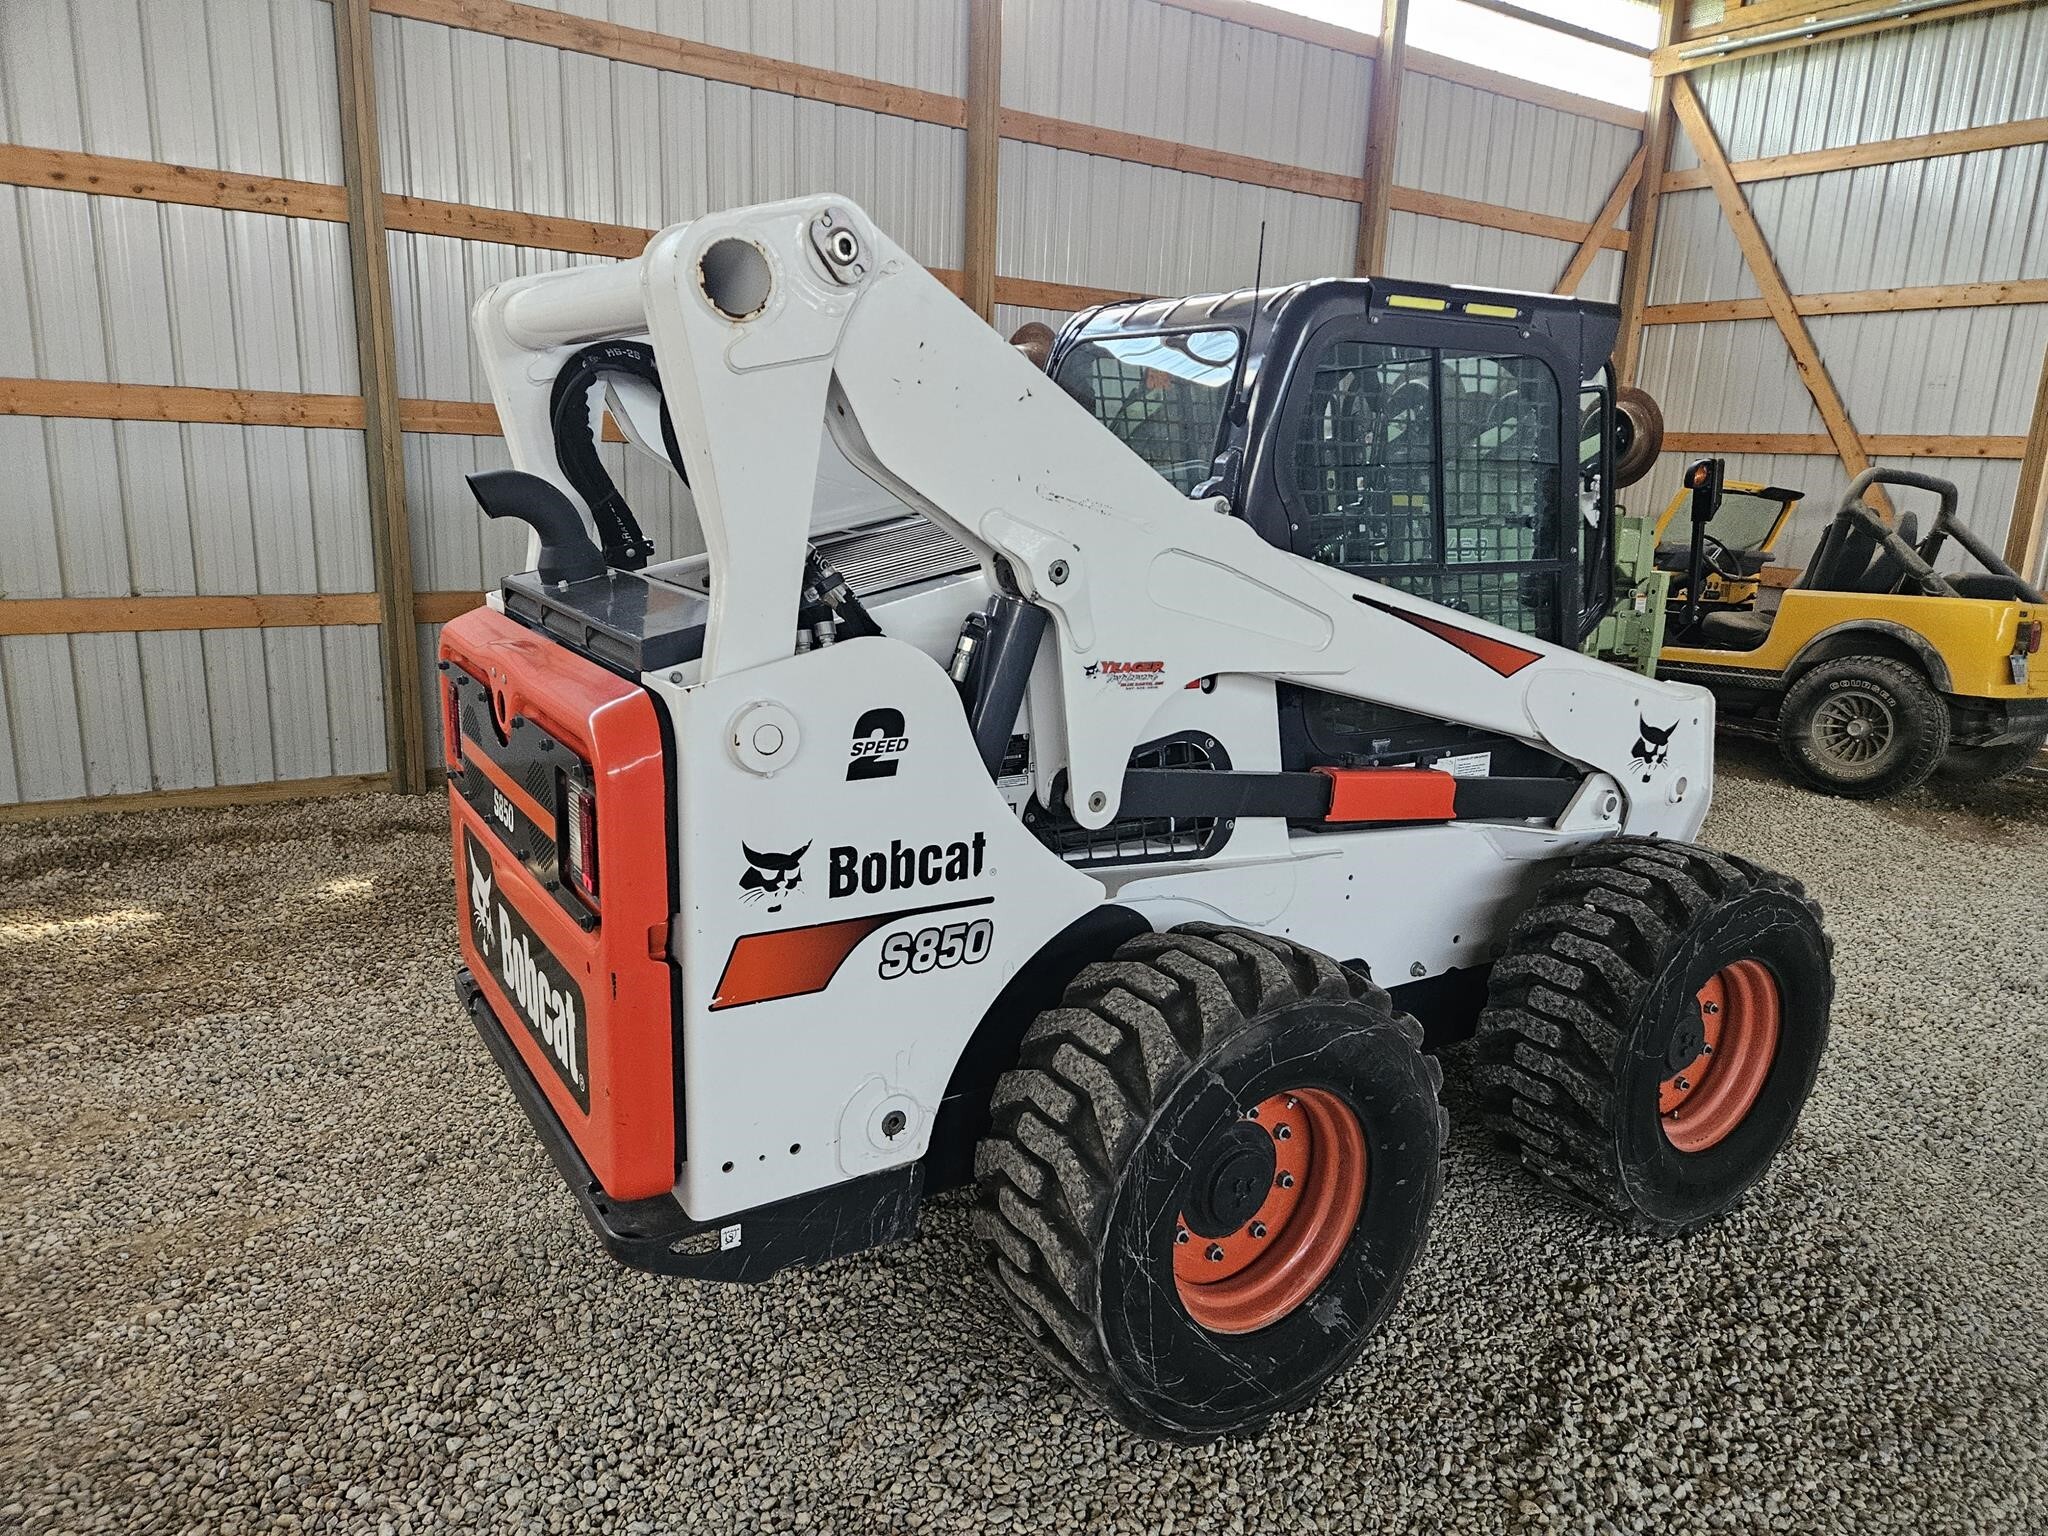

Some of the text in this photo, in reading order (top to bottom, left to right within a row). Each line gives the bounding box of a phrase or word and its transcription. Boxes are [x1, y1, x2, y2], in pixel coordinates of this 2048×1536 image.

[1101, 660, 1165, 674] YEAGER
[1829, 679, 1896, 708] COURSER
[846, 707, 905, 782] 2
[850, 738, 909, 757] SPEED
[493, 788, 515, 833] S850
[829, 831, 987, 899] Bobcat
[878, 918, 994, 981] S850
[498, 902, 579, 1085] Bobcat
